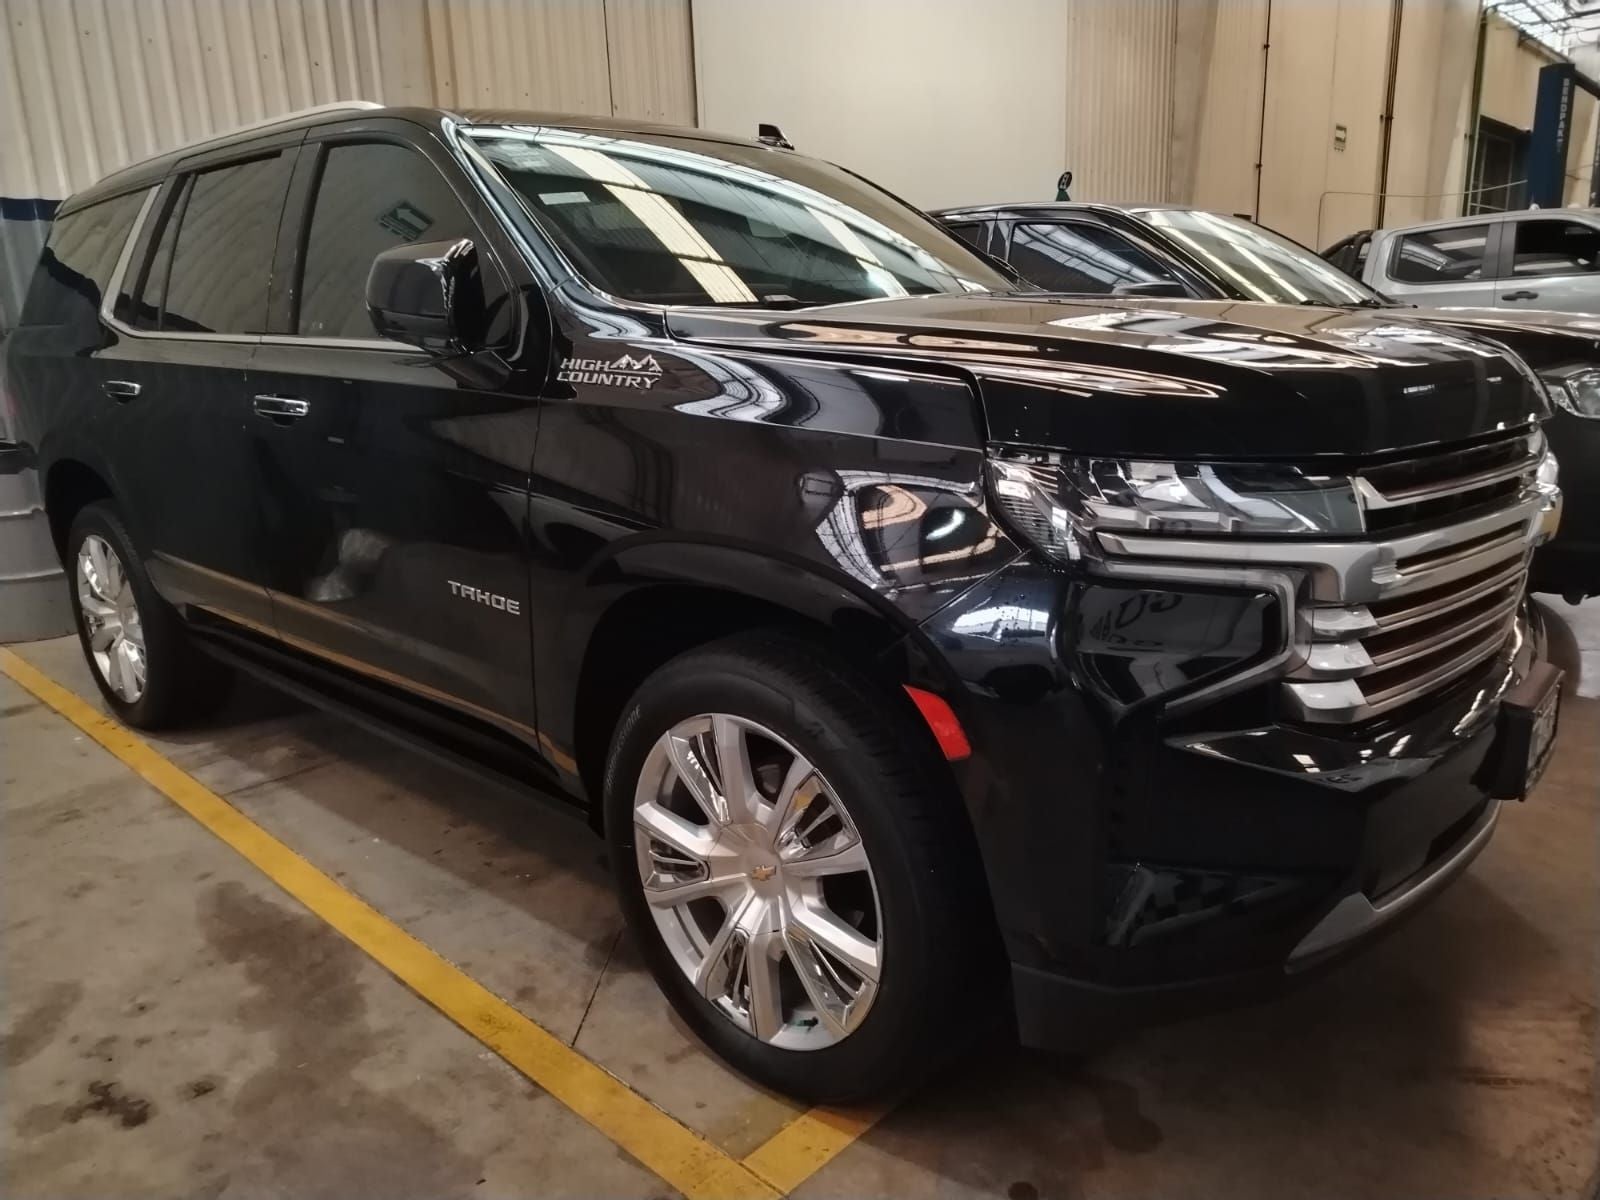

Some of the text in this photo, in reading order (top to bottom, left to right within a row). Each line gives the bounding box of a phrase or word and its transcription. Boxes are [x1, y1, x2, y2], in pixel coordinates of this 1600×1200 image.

[560, 357, 610, 371] HIGH
[556, 370, 660, 389] COUNTRY
[447, 579, 521, 616] TAHOE
